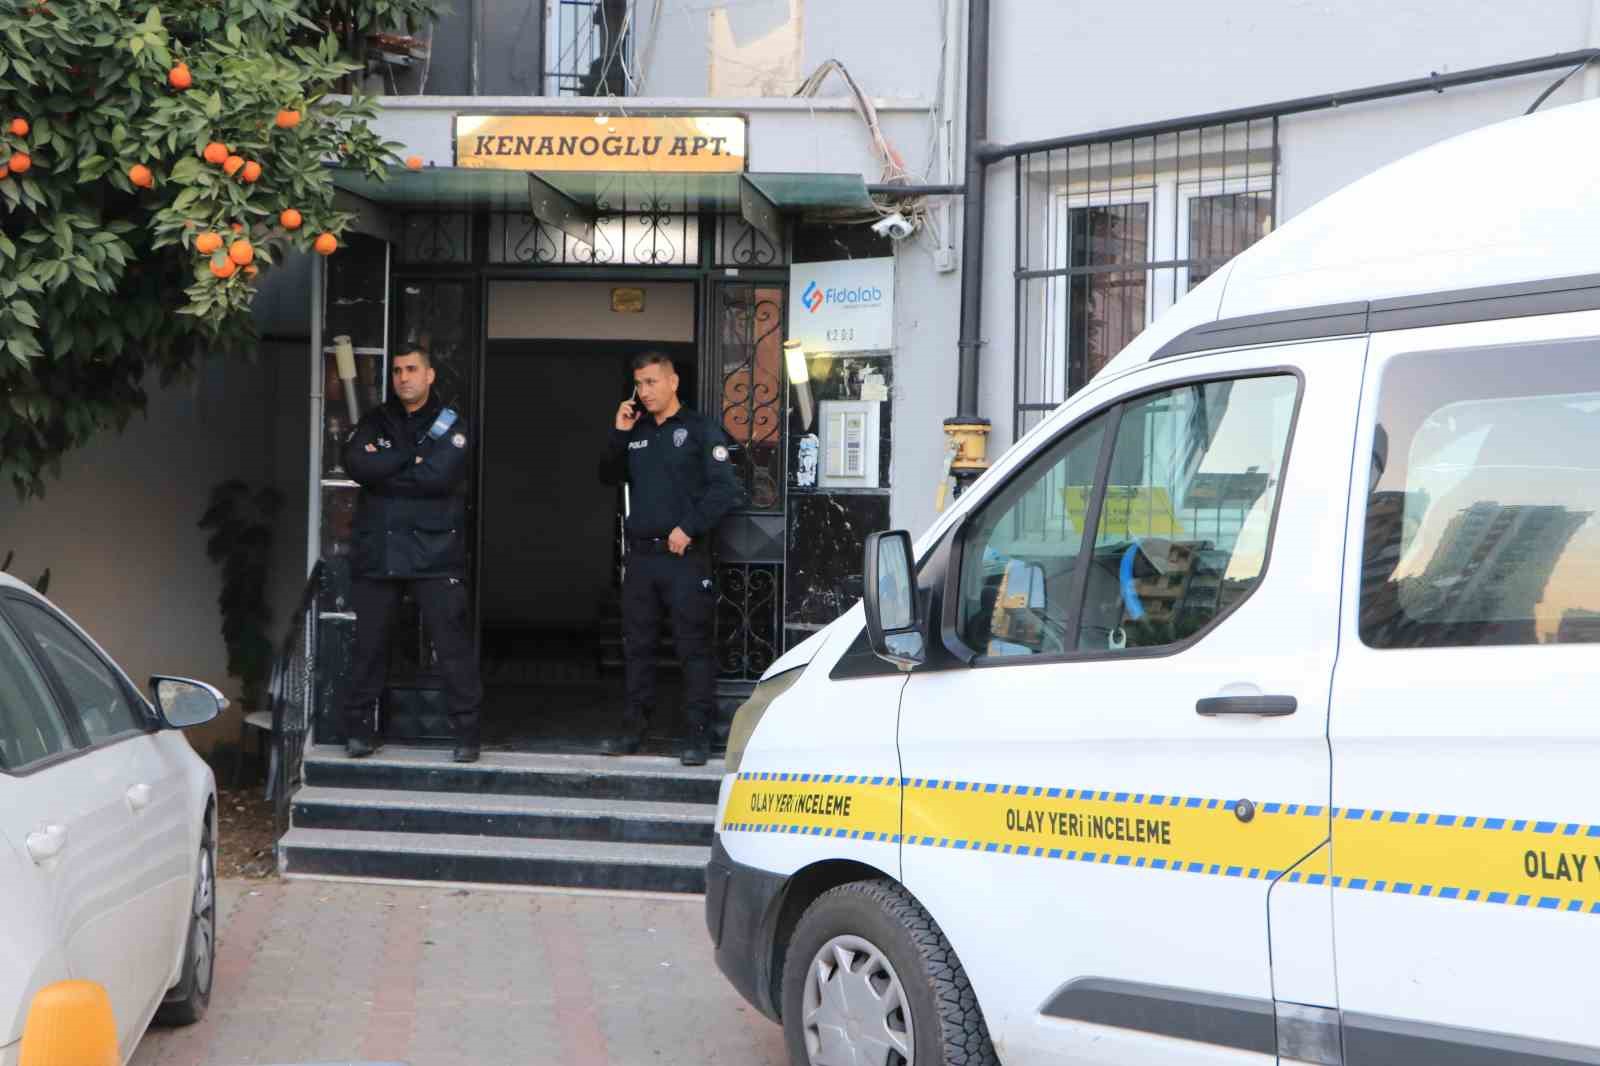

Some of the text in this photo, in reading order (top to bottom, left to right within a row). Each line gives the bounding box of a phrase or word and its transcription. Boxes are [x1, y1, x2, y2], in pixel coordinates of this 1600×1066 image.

[668, 135, 731, 156] APT.
[751, 793, 775, 812] OLAY
[1006, 808, 1045, 833] OLAY
[1524, 849, 1587, 882] OLAY
